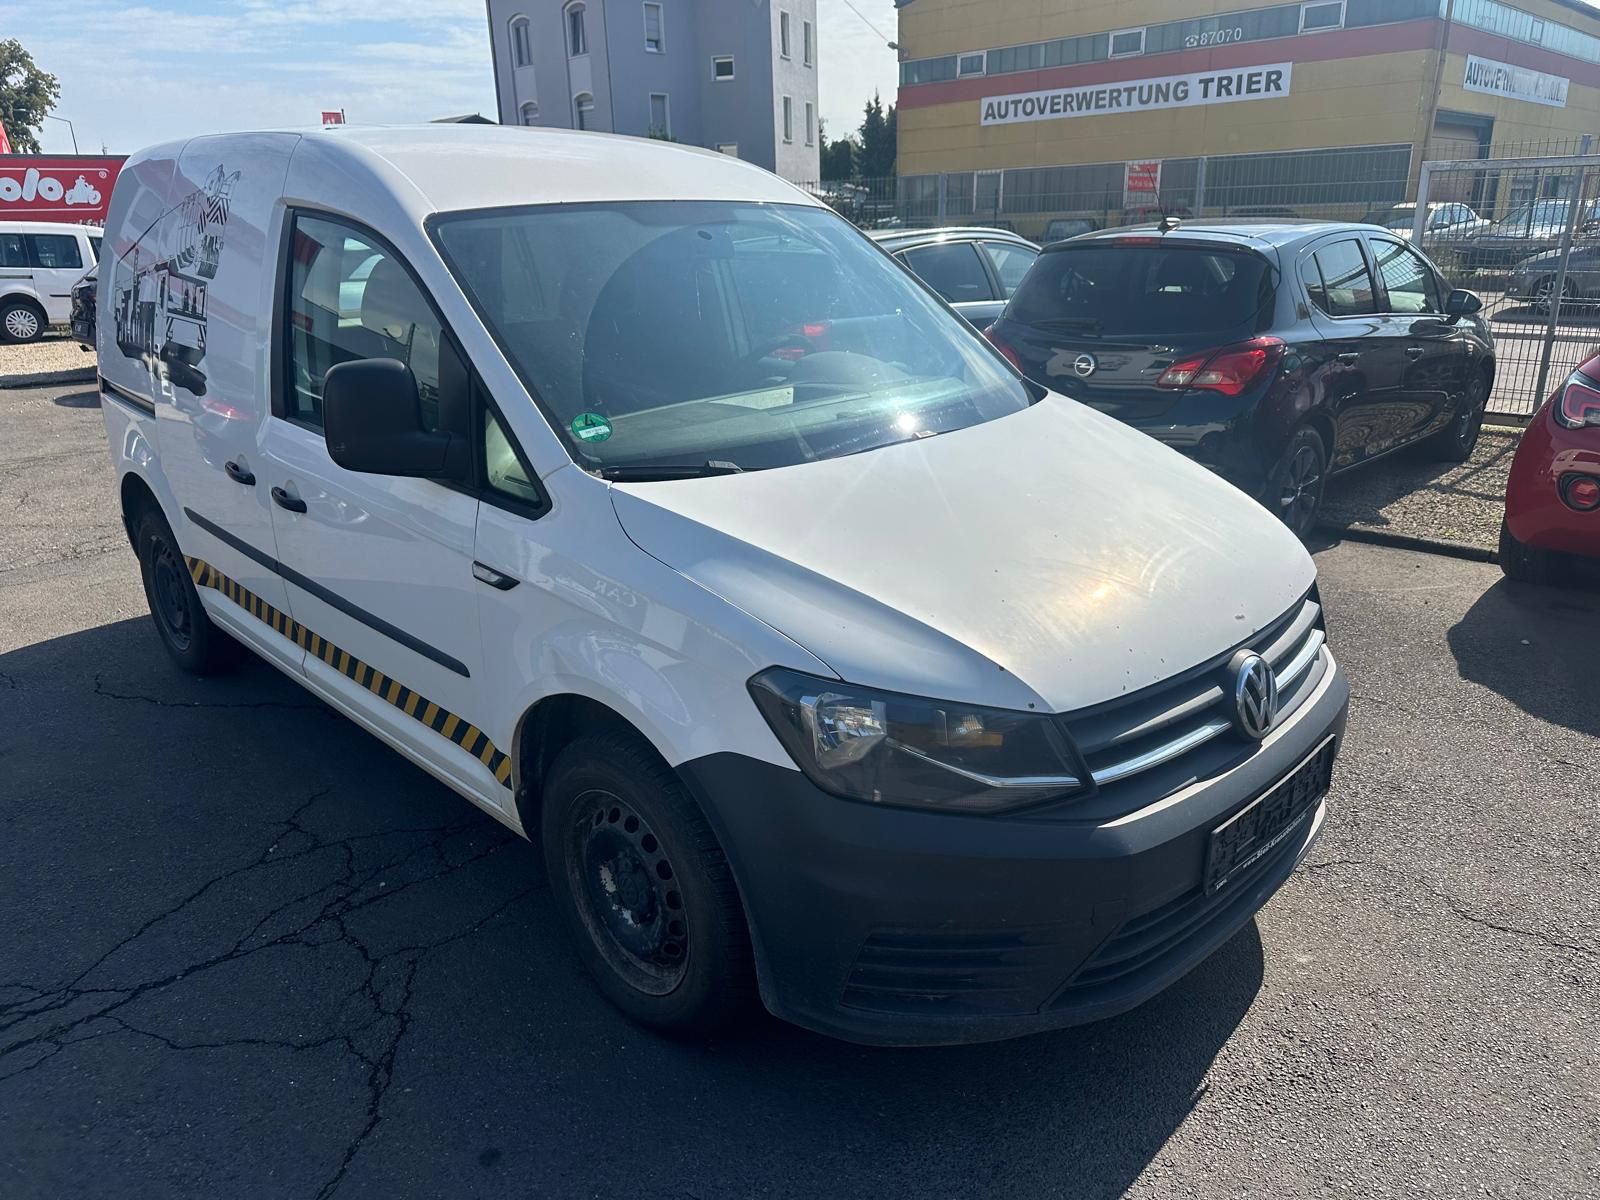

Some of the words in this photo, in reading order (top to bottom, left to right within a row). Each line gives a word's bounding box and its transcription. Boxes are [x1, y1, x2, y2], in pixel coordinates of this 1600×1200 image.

[1200, 27, 1242, 45] 87070
[984, 80, 1189, 121] AUTOVERWERTUNG
[1199, 70, 1282, 99] TRIER
[585, 414, 596, 427] 4
[1237, 656, 1277, 738] VW
